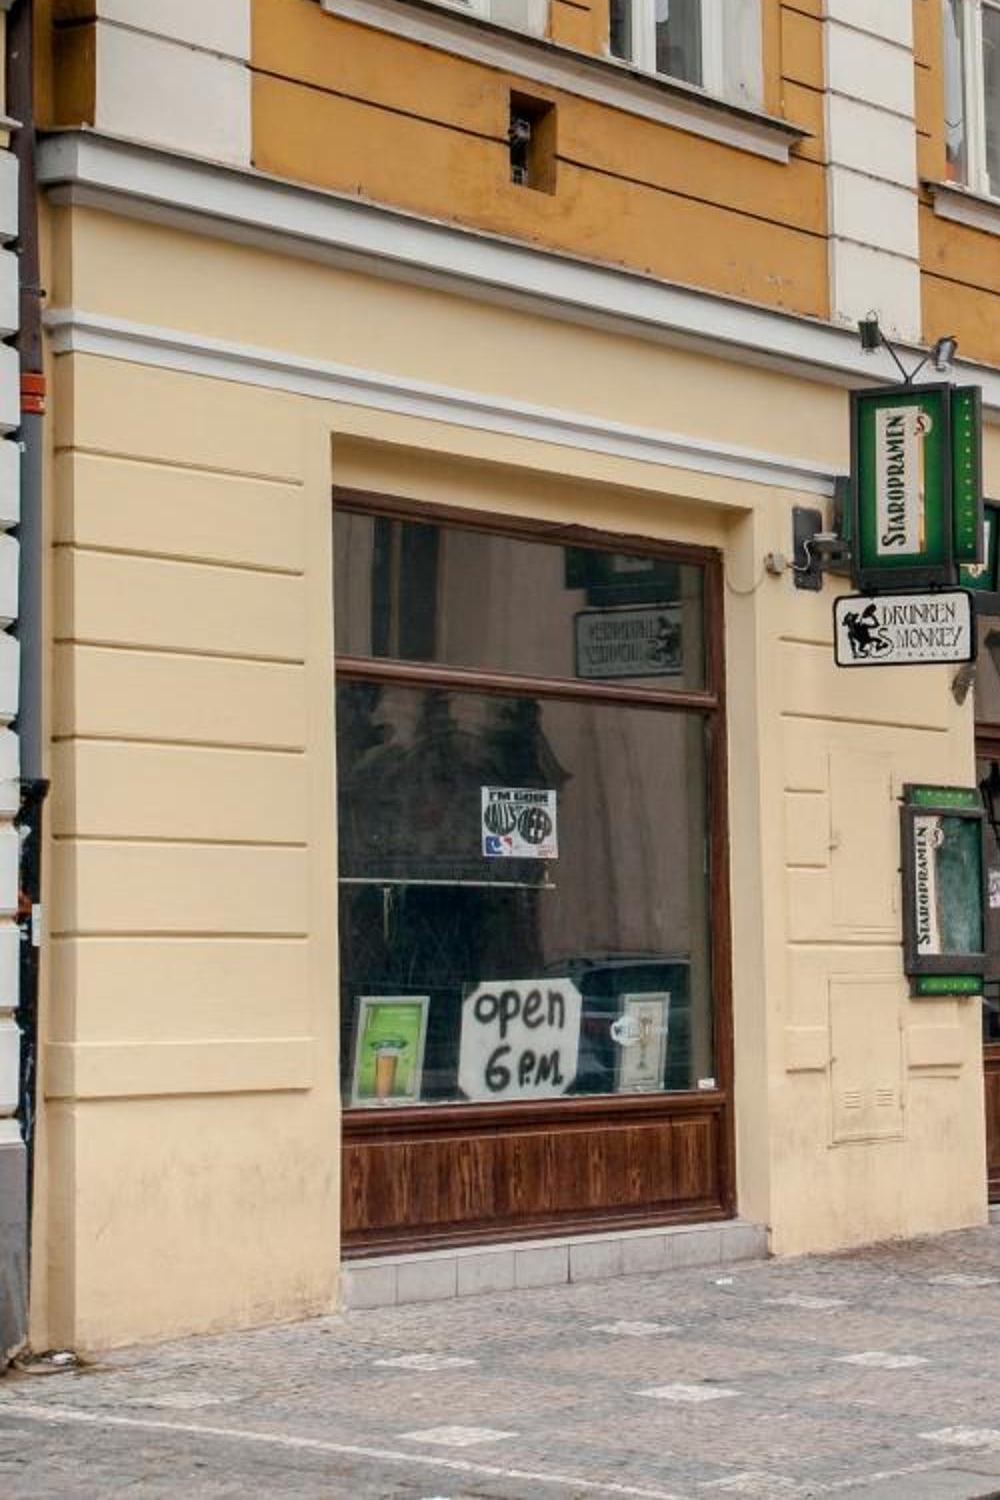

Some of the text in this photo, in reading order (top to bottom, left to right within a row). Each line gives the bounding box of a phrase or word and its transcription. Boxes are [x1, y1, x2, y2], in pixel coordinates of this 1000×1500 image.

[880, 414, 906, 547] STAROPRAMEN
[882, 602, 955, 626] DRUNKEN
[896, 625, 963, 649] MONKEY
[474, 988, 566, 1040] open
[484, 1044, 511, 1093] 6
